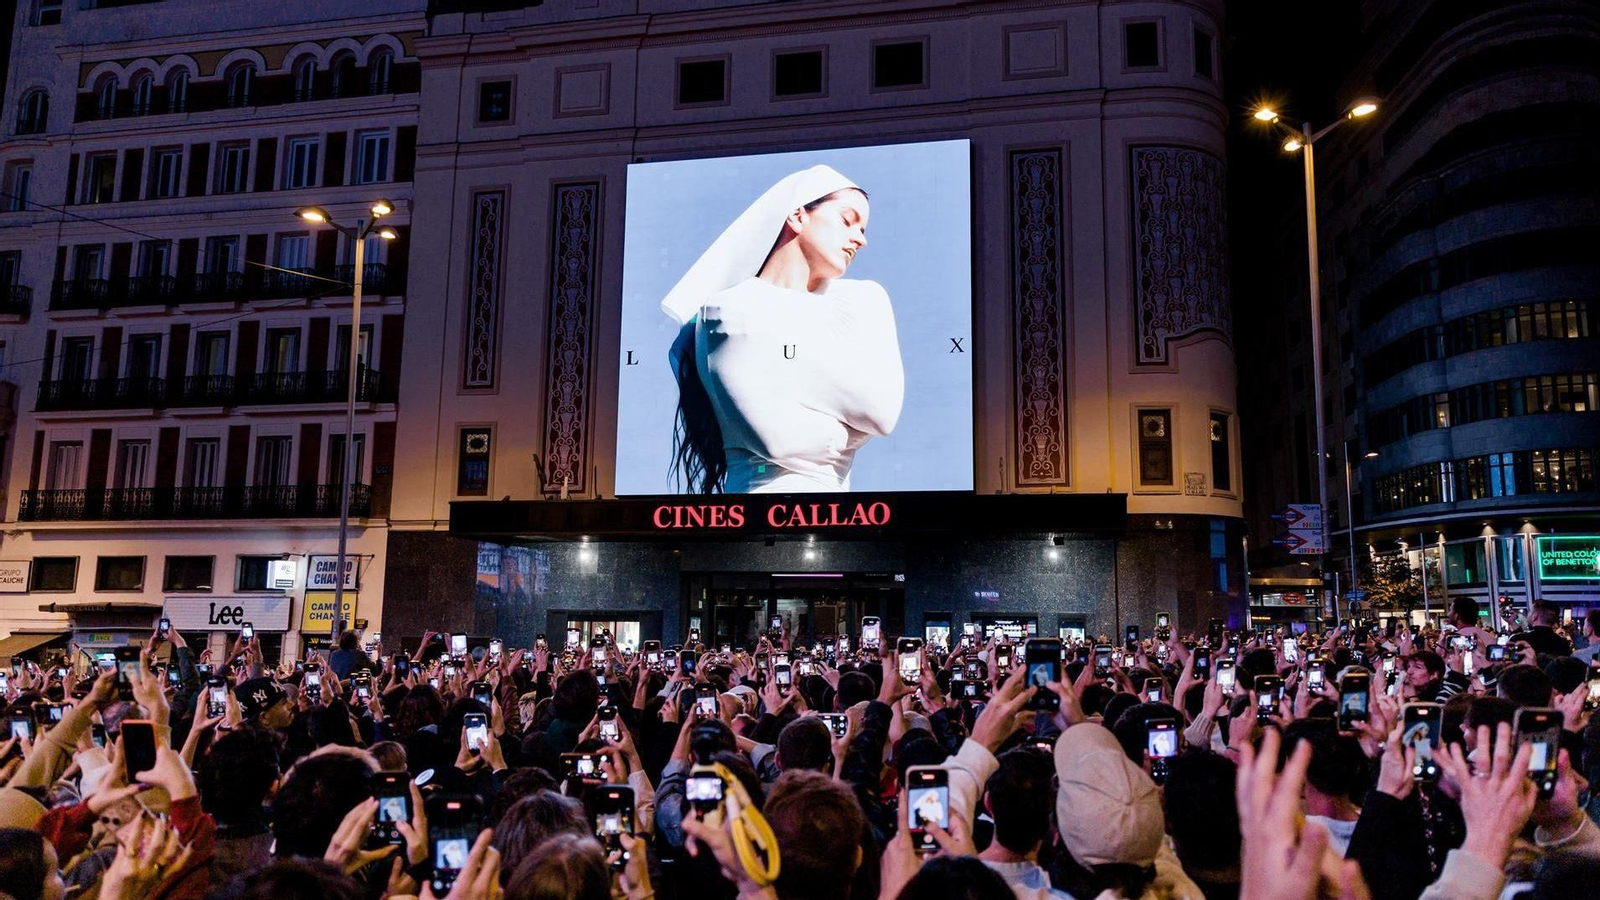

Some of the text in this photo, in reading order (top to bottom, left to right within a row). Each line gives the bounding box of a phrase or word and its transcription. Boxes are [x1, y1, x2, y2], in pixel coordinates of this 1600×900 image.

[625, 337, 965, 366] L U X
[653, 502, 892, 529] CINES CALLAO
[1556, 558, 1597, 566] BENETTON
[208, 602, 244, 625] Lee
[311, 603, 350, 611] CAMO
